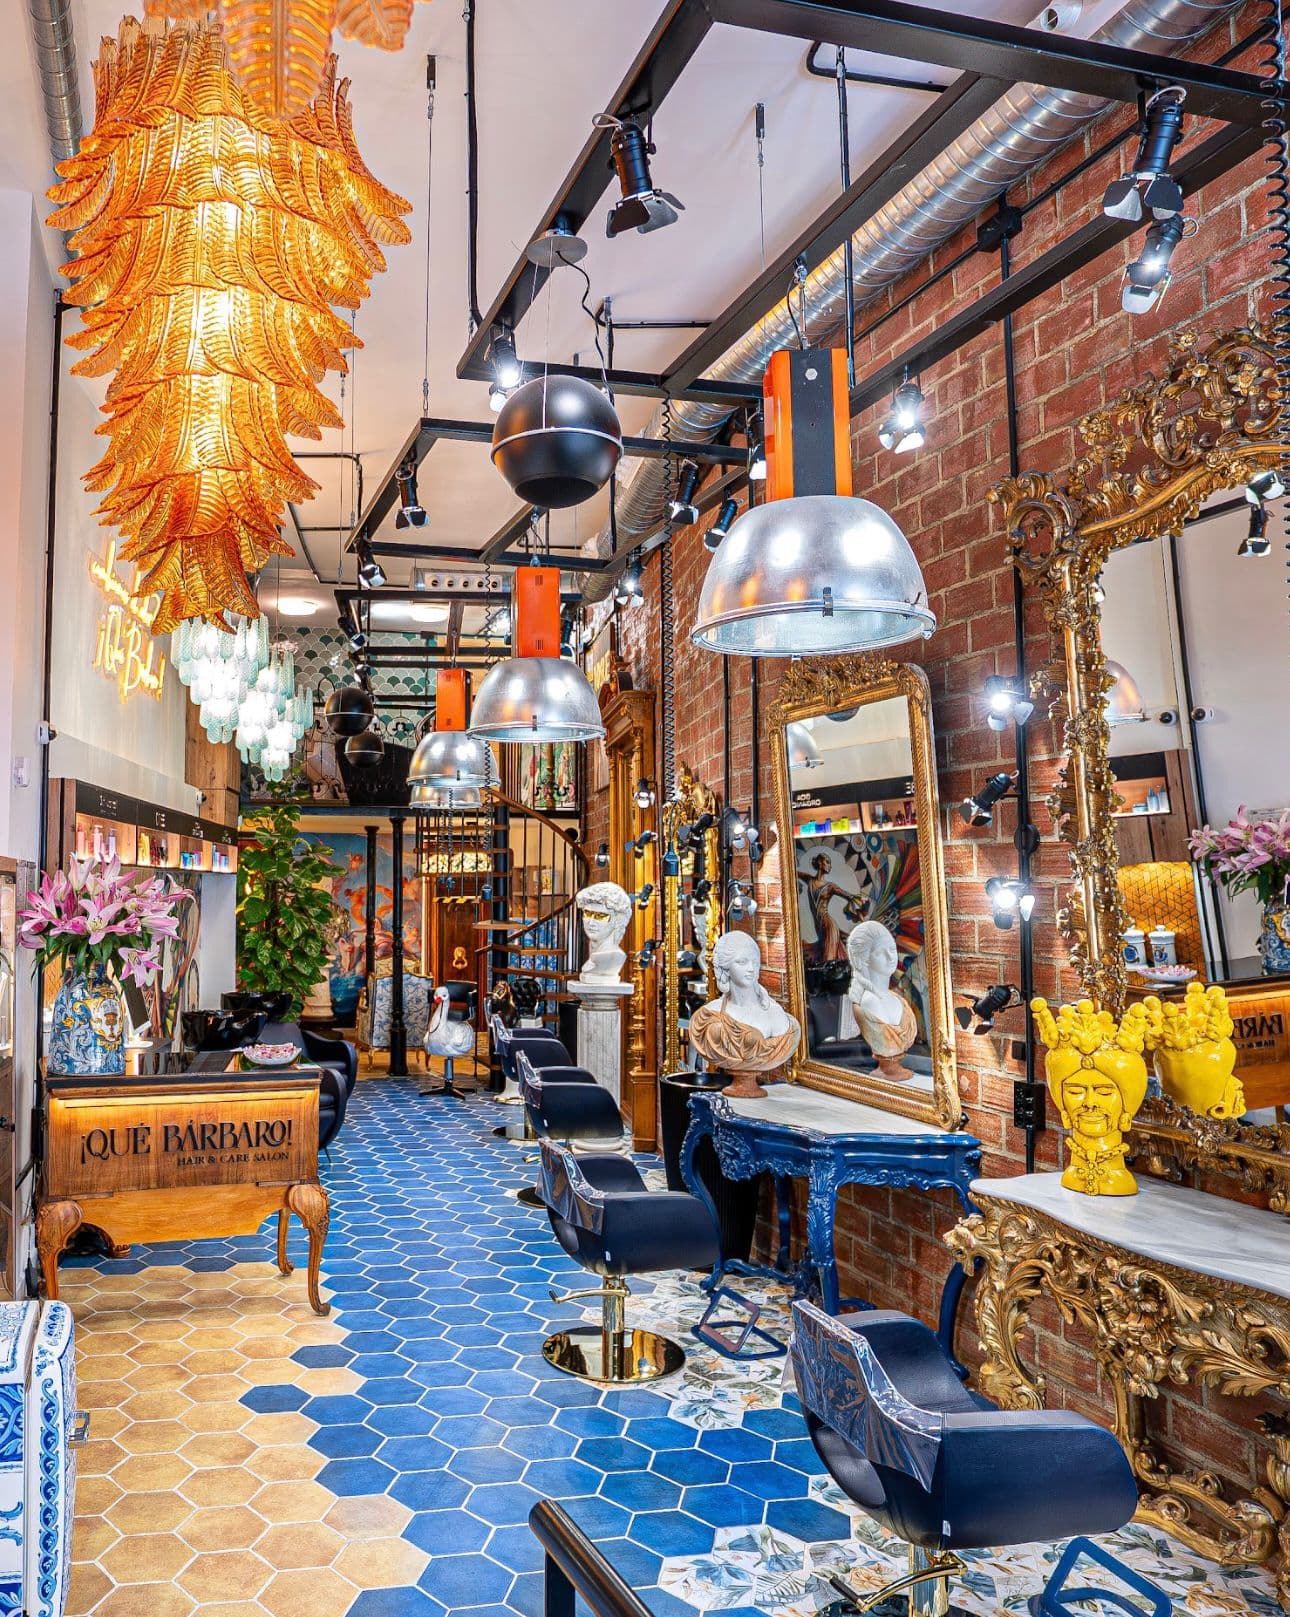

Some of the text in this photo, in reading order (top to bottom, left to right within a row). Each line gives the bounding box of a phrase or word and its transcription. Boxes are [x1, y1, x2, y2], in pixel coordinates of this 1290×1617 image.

[80, 1119, 293, 1164] ¡QUÉ BÁRBARO!
[177, 1151, 289, 1167] HAIR & CARE SALON
